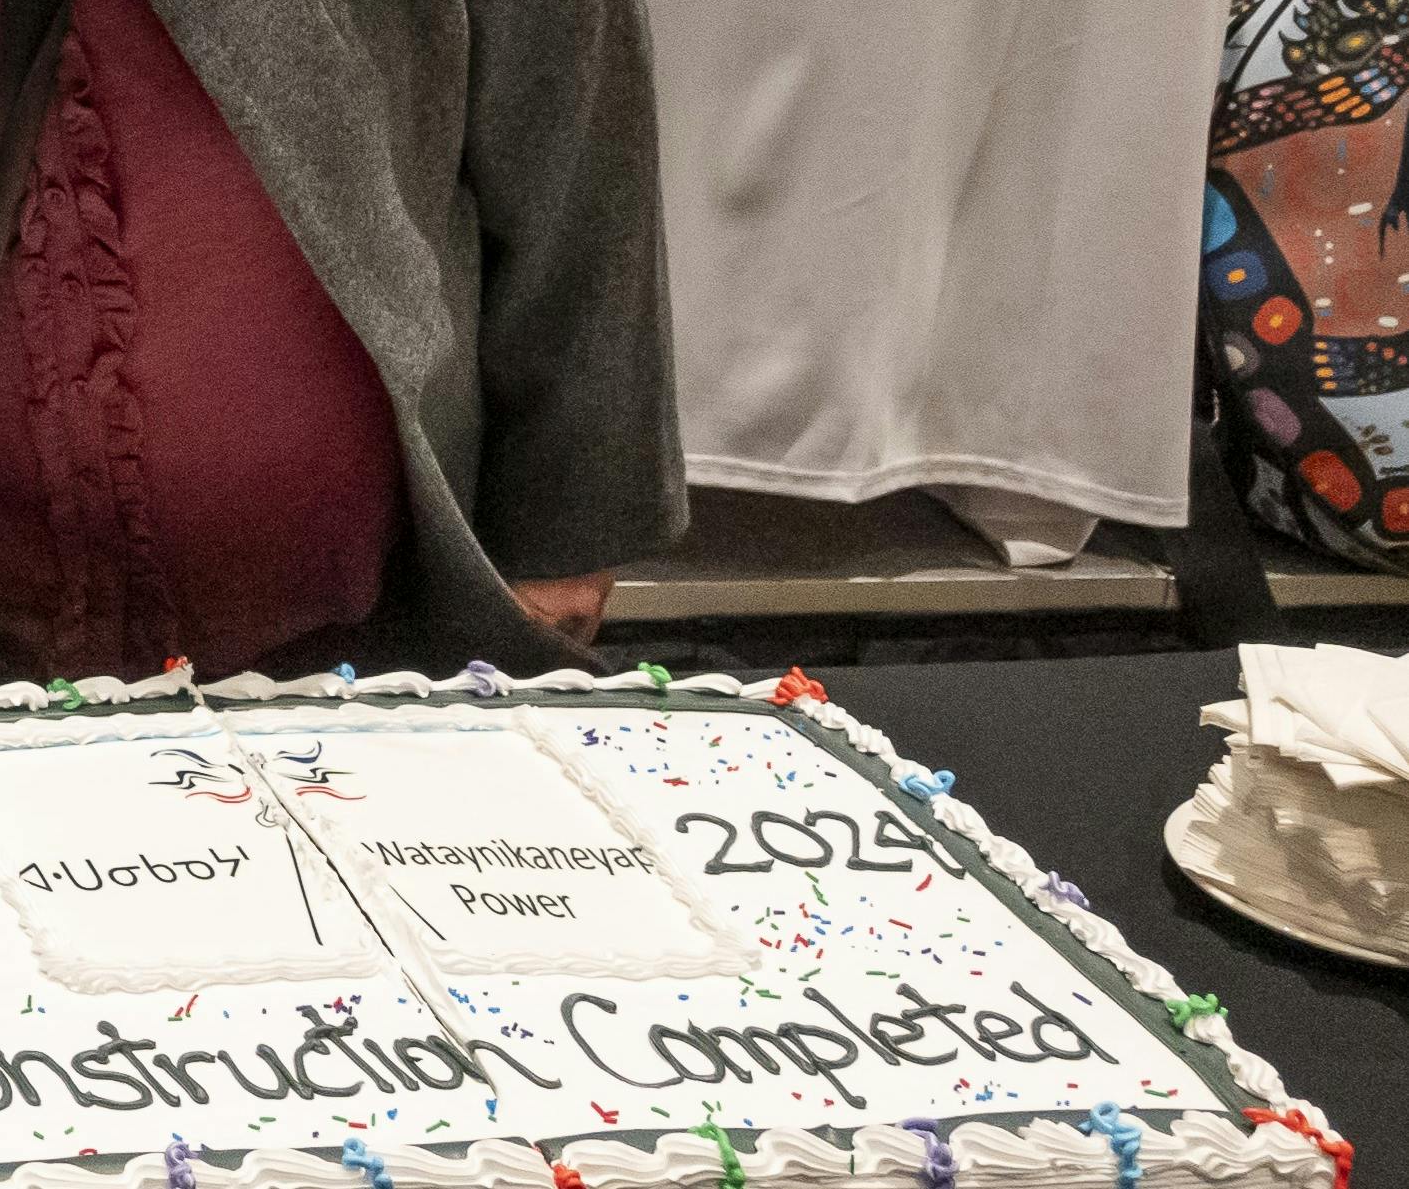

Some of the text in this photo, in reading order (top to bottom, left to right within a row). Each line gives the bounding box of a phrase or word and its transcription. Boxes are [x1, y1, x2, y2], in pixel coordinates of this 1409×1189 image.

[675, 807, 967, 880] 2024
[449, 883, 577, 919] Power
[560, 981, 1120, 1109] Completed
